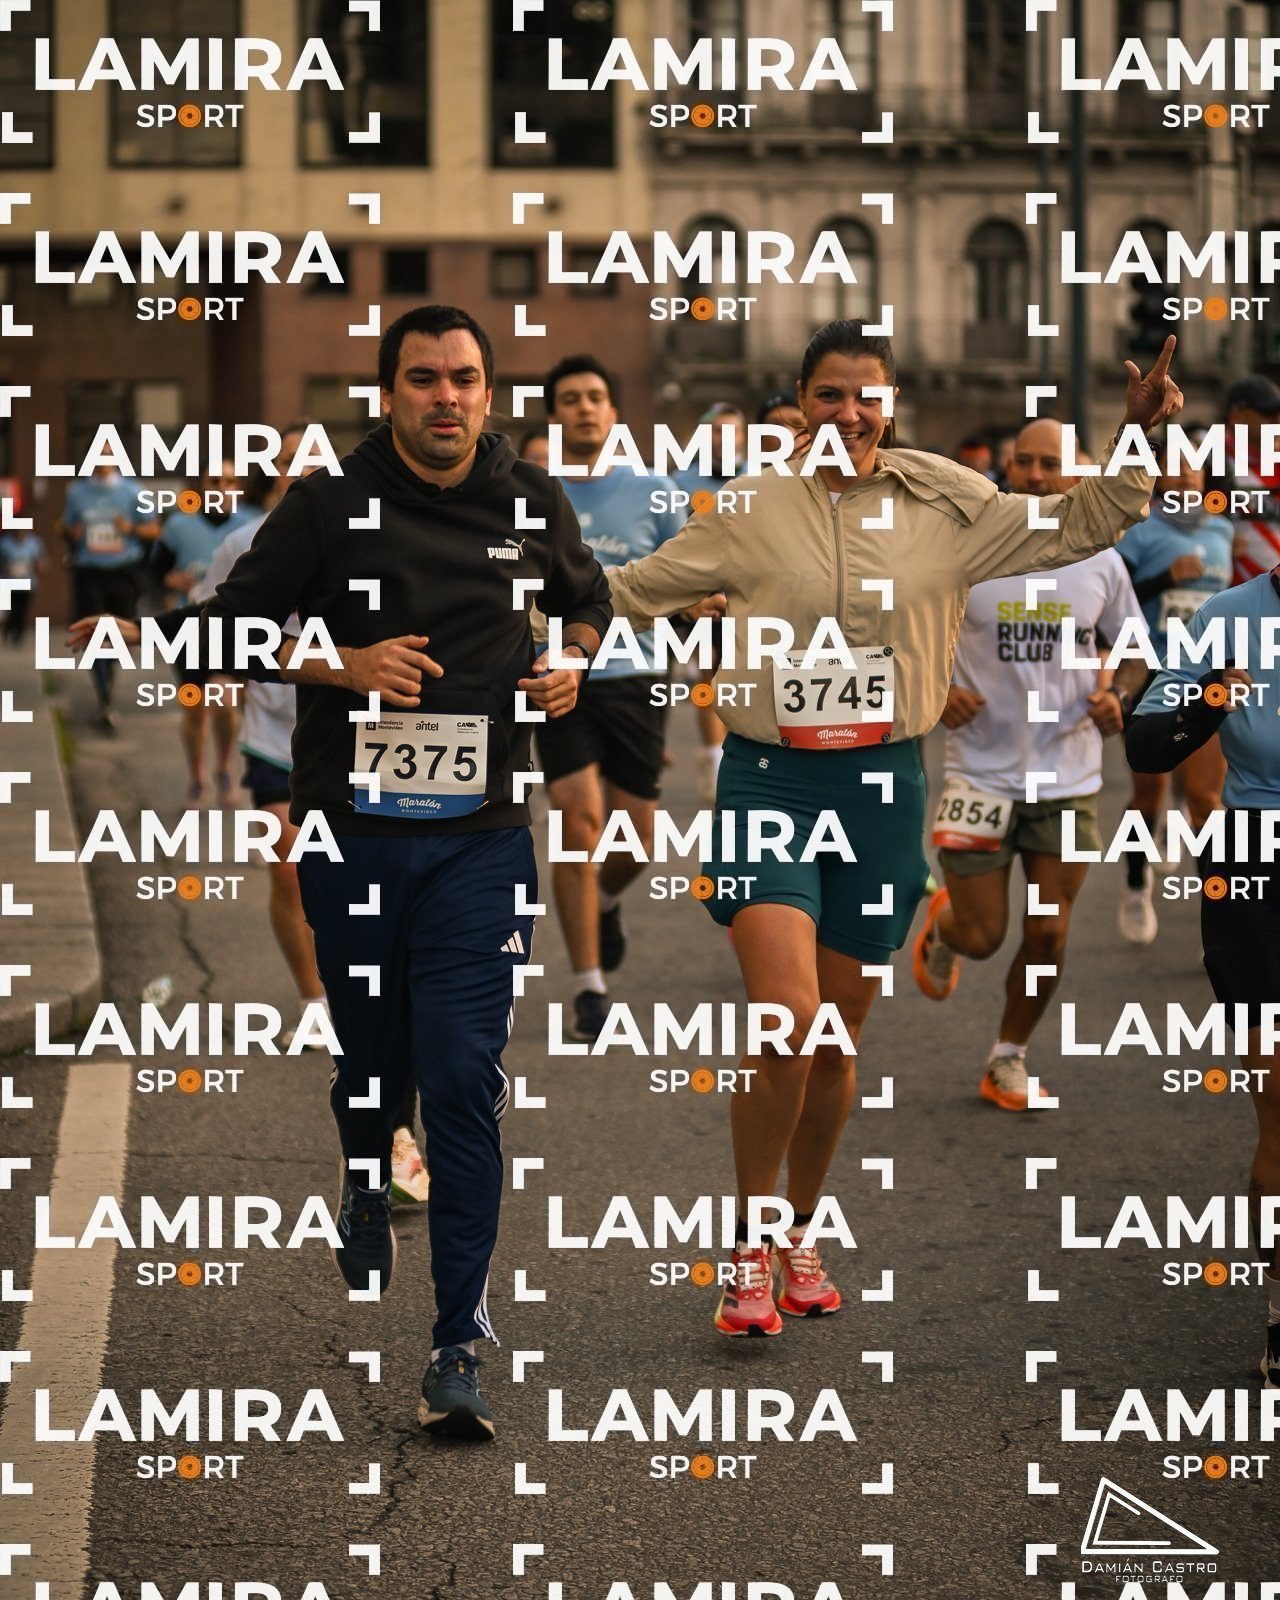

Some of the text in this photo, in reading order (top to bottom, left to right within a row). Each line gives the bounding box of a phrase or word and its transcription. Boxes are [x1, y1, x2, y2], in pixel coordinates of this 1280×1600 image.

[487, 547, 519, 561] PUMA
[996, 600, 1072, 622] SENSE
[997, 622, 1093, 645] RUNNG
[998, 642, 1054, 662] CLUB
[783, 675, 886, 713] 3745
[415, 720, 439, 732] antel
[817, 728, 858, 740] Maratón
[364, 741, 478, 782] 7375
[396, 797, 442, 810] Maratón
[937, 798, 1003, 830] 2854
